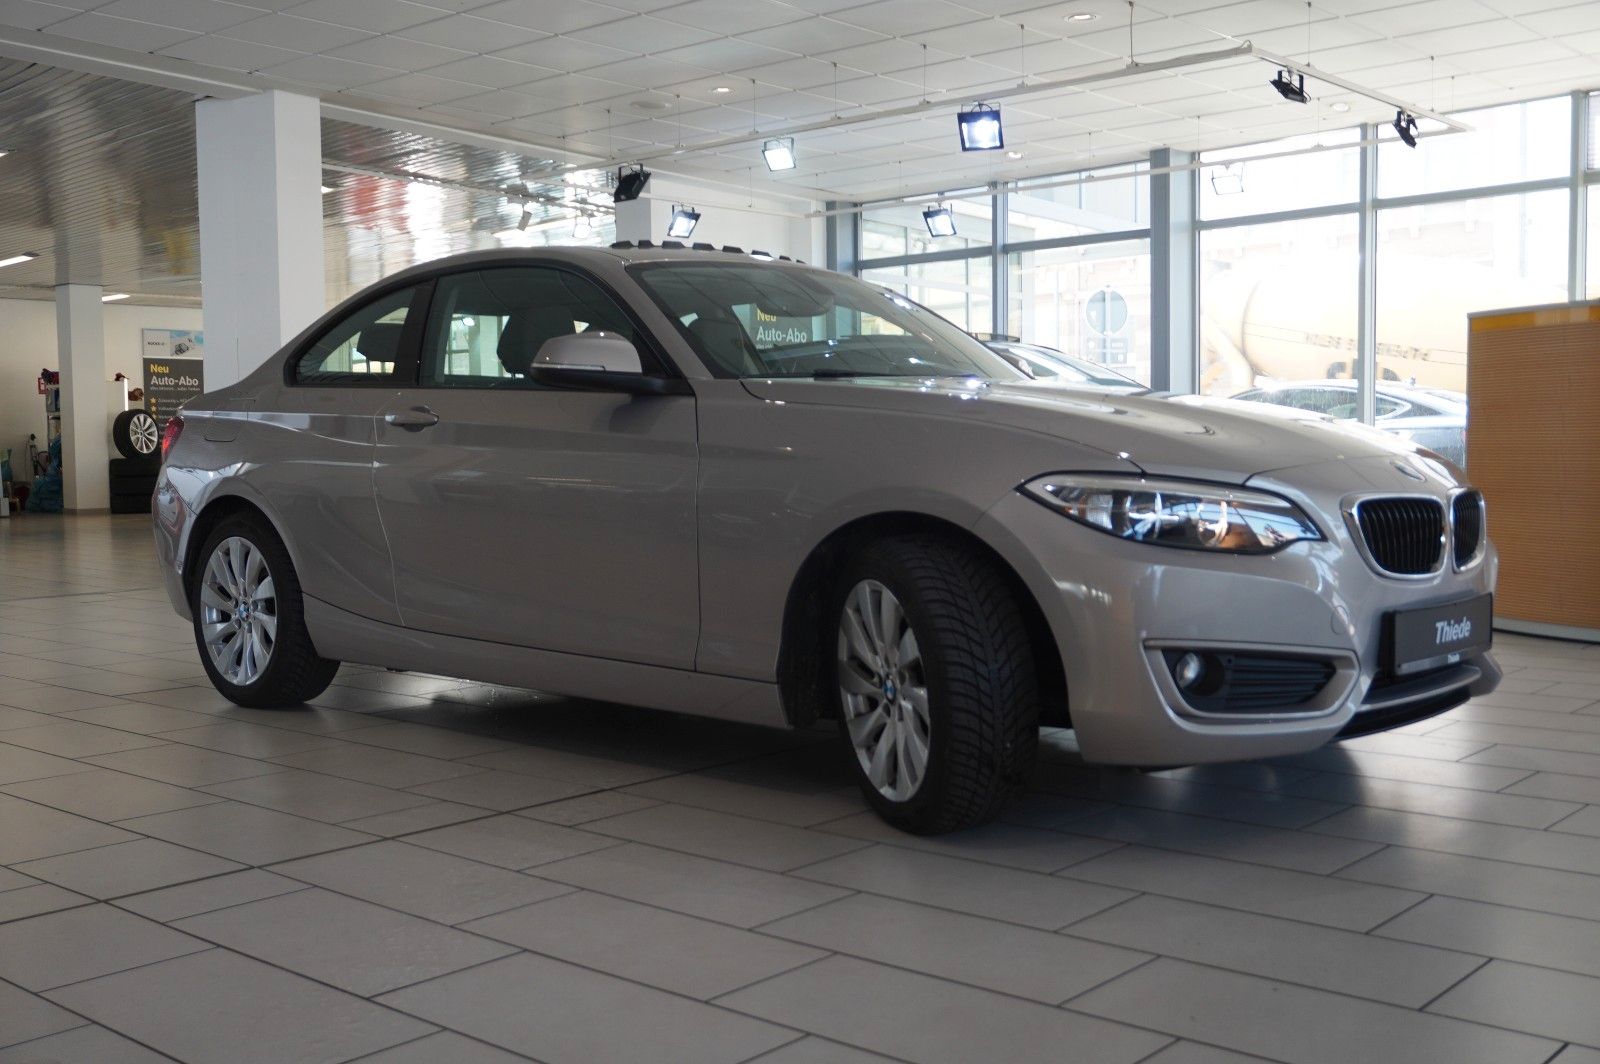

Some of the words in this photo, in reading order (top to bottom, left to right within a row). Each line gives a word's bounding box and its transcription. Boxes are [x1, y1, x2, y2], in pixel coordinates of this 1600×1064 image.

[757, 309, 776, 321] Neu
[756, 327, 807, 344] Auto-Abo
[150, 364, 169, 373] Neu
[151, 376, 199, 386] Auto-Abo
[1435, 616, 1471, 644] Thiede
